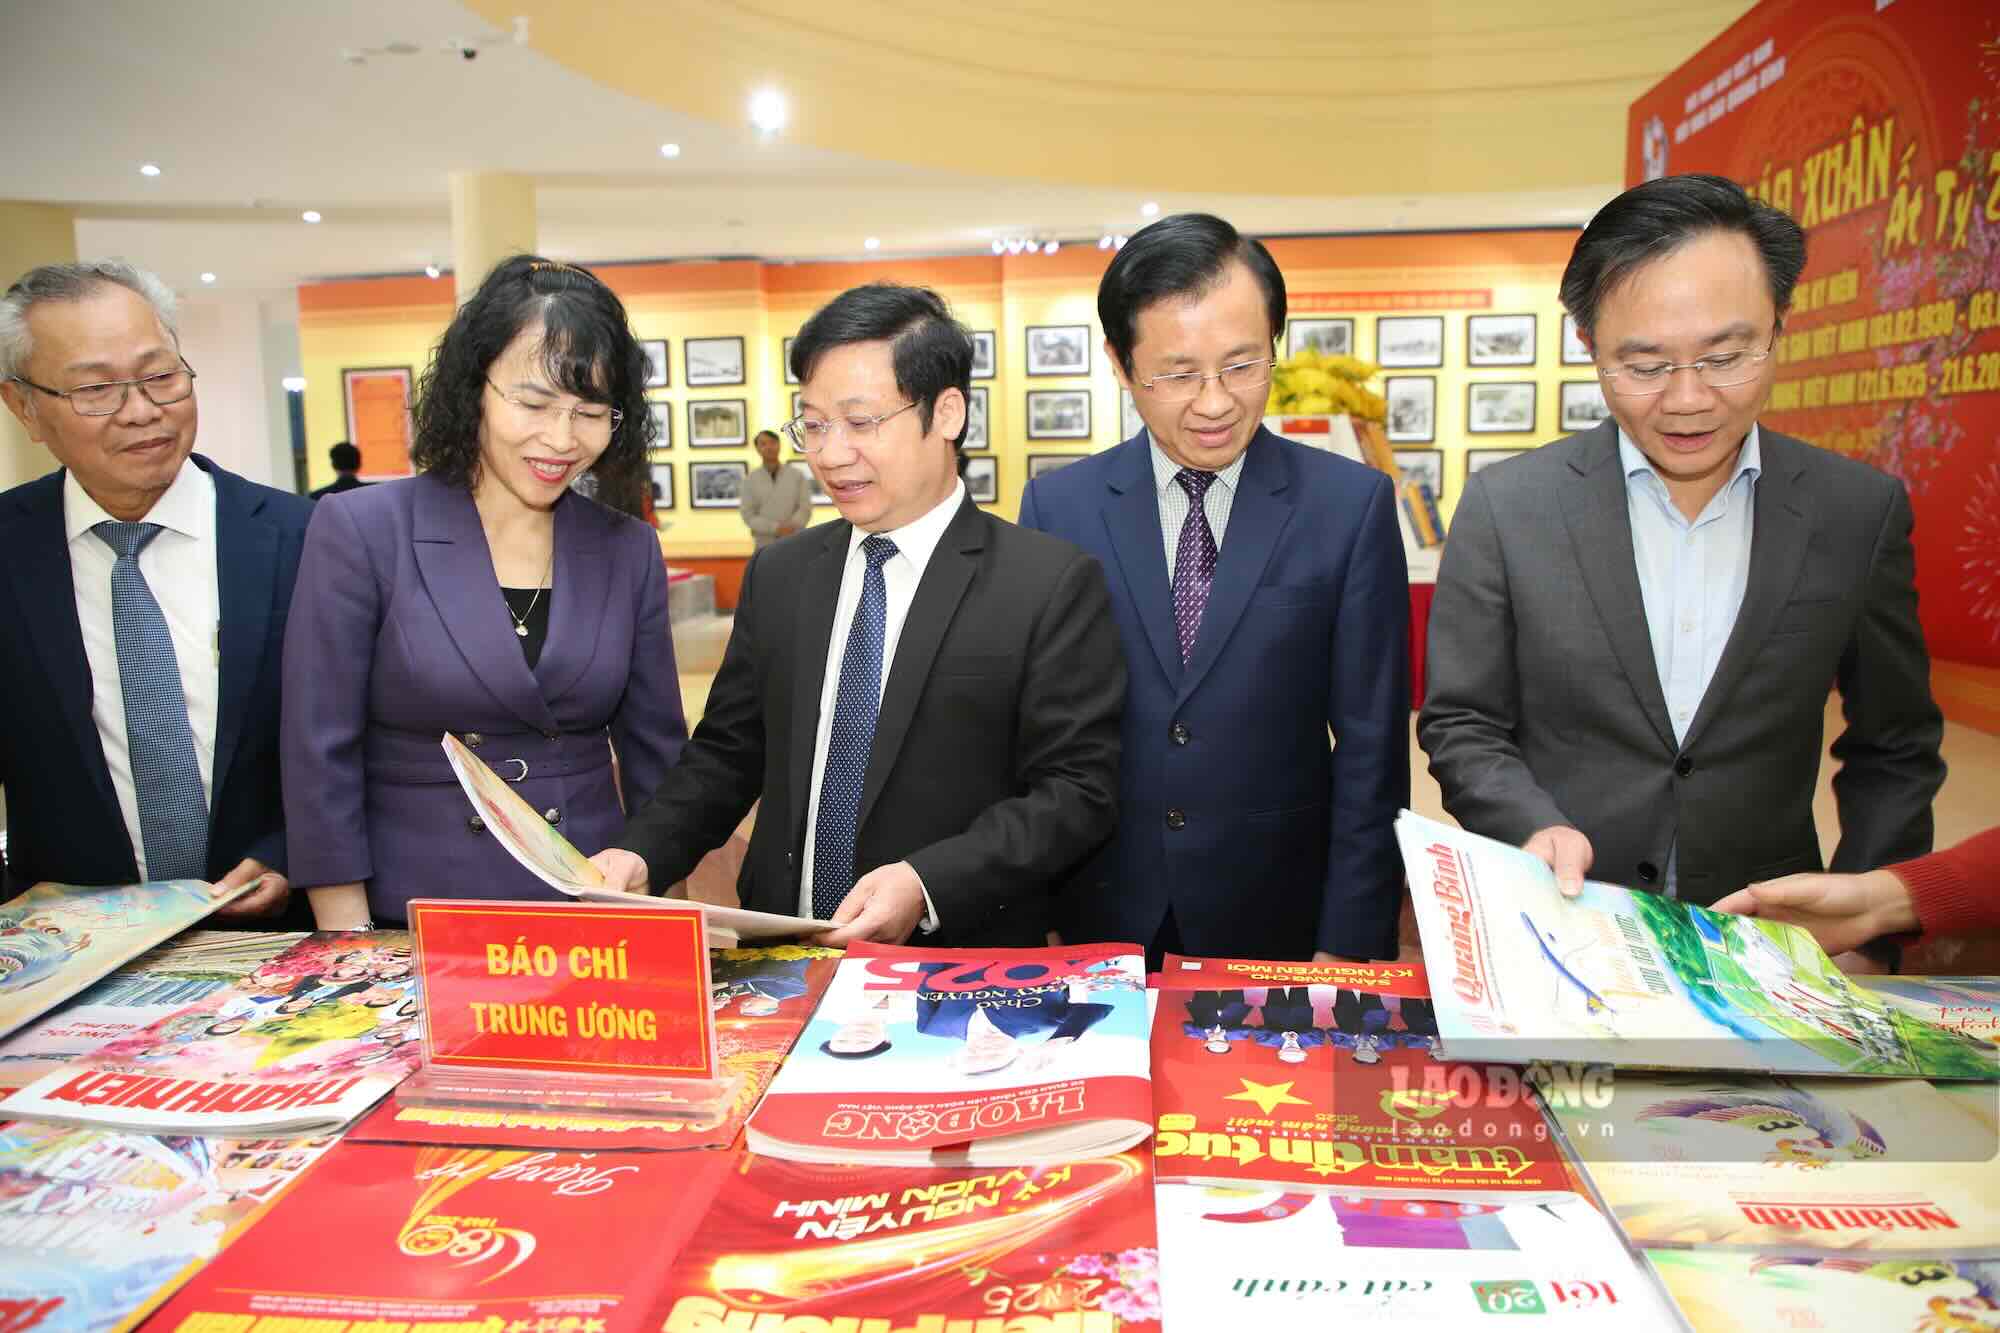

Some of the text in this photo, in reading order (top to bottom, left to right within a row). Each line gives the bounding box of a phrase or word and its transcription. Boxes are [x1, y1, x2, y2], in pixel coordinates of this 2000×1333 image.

[1802, 116, 1894, 228] XUÂN
[485, 936, 629, 980] BÁO CHÍ
[469, 1001, 658, 1041] TRUNG ƯƠNG
[172, 1077, 364, 1114] THANH
[977, 1086, 1085, 1127] LAO
[1267, 1137, 1371, 1177] tin
[772, 1169, 1027, 1220] VƯƠN MÌNH
[794, 1191, 1001, 1240] NGUYÊN
[1837, 1206, 1960, 1232] Nhân
